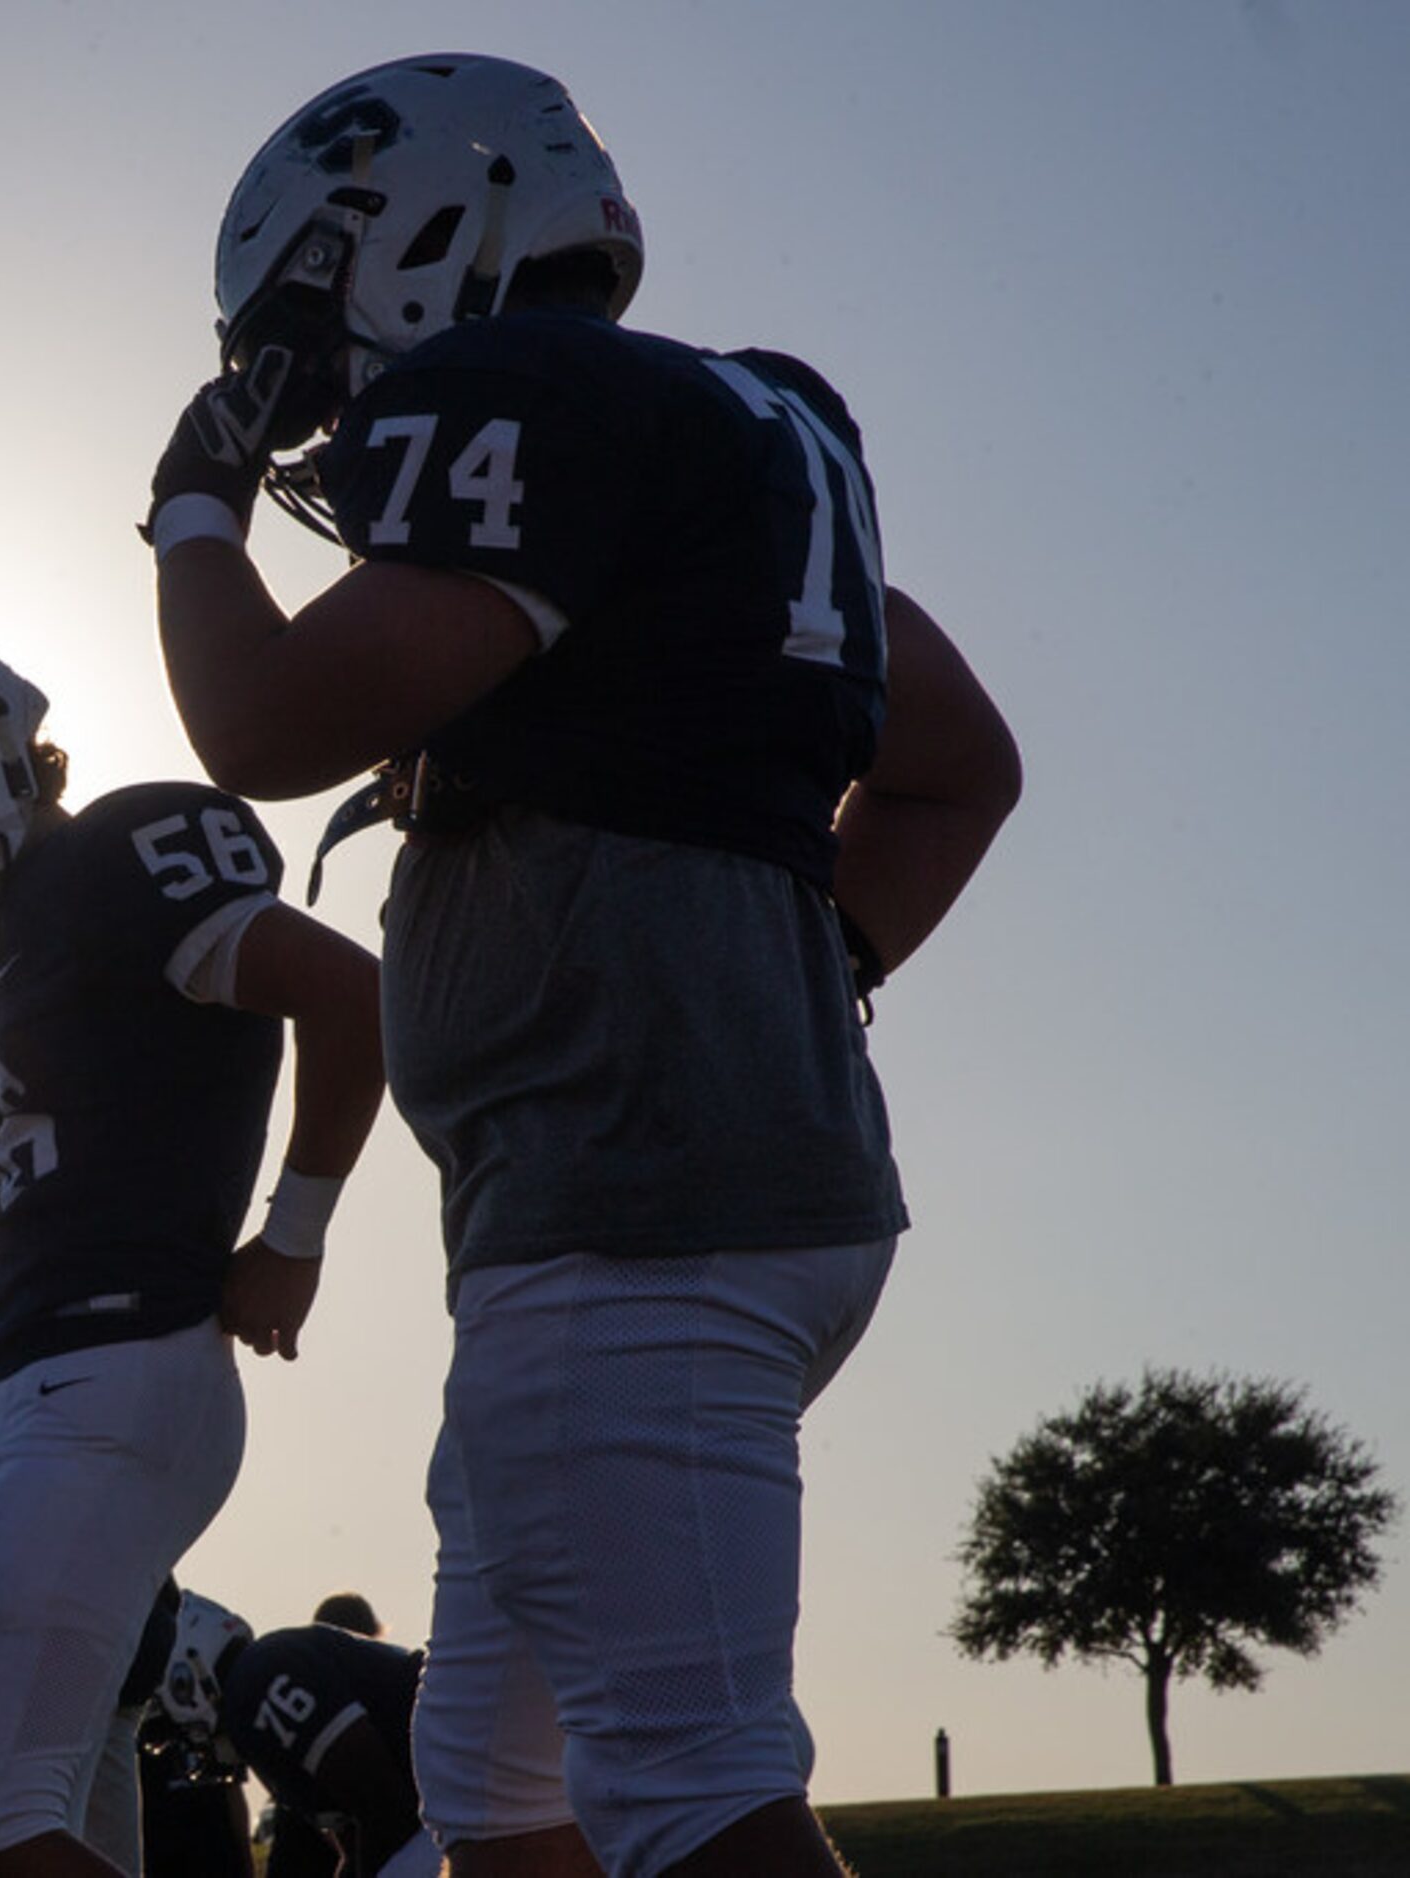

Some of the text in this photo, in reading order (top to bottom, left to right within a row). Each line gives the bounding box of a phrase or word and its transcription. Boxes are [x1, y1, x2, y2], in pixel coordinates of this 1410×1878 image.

[365, 413, 525, 550] 74
[131, 806, 268, 901] 56
[252, 1673, 316, 1749] 76
